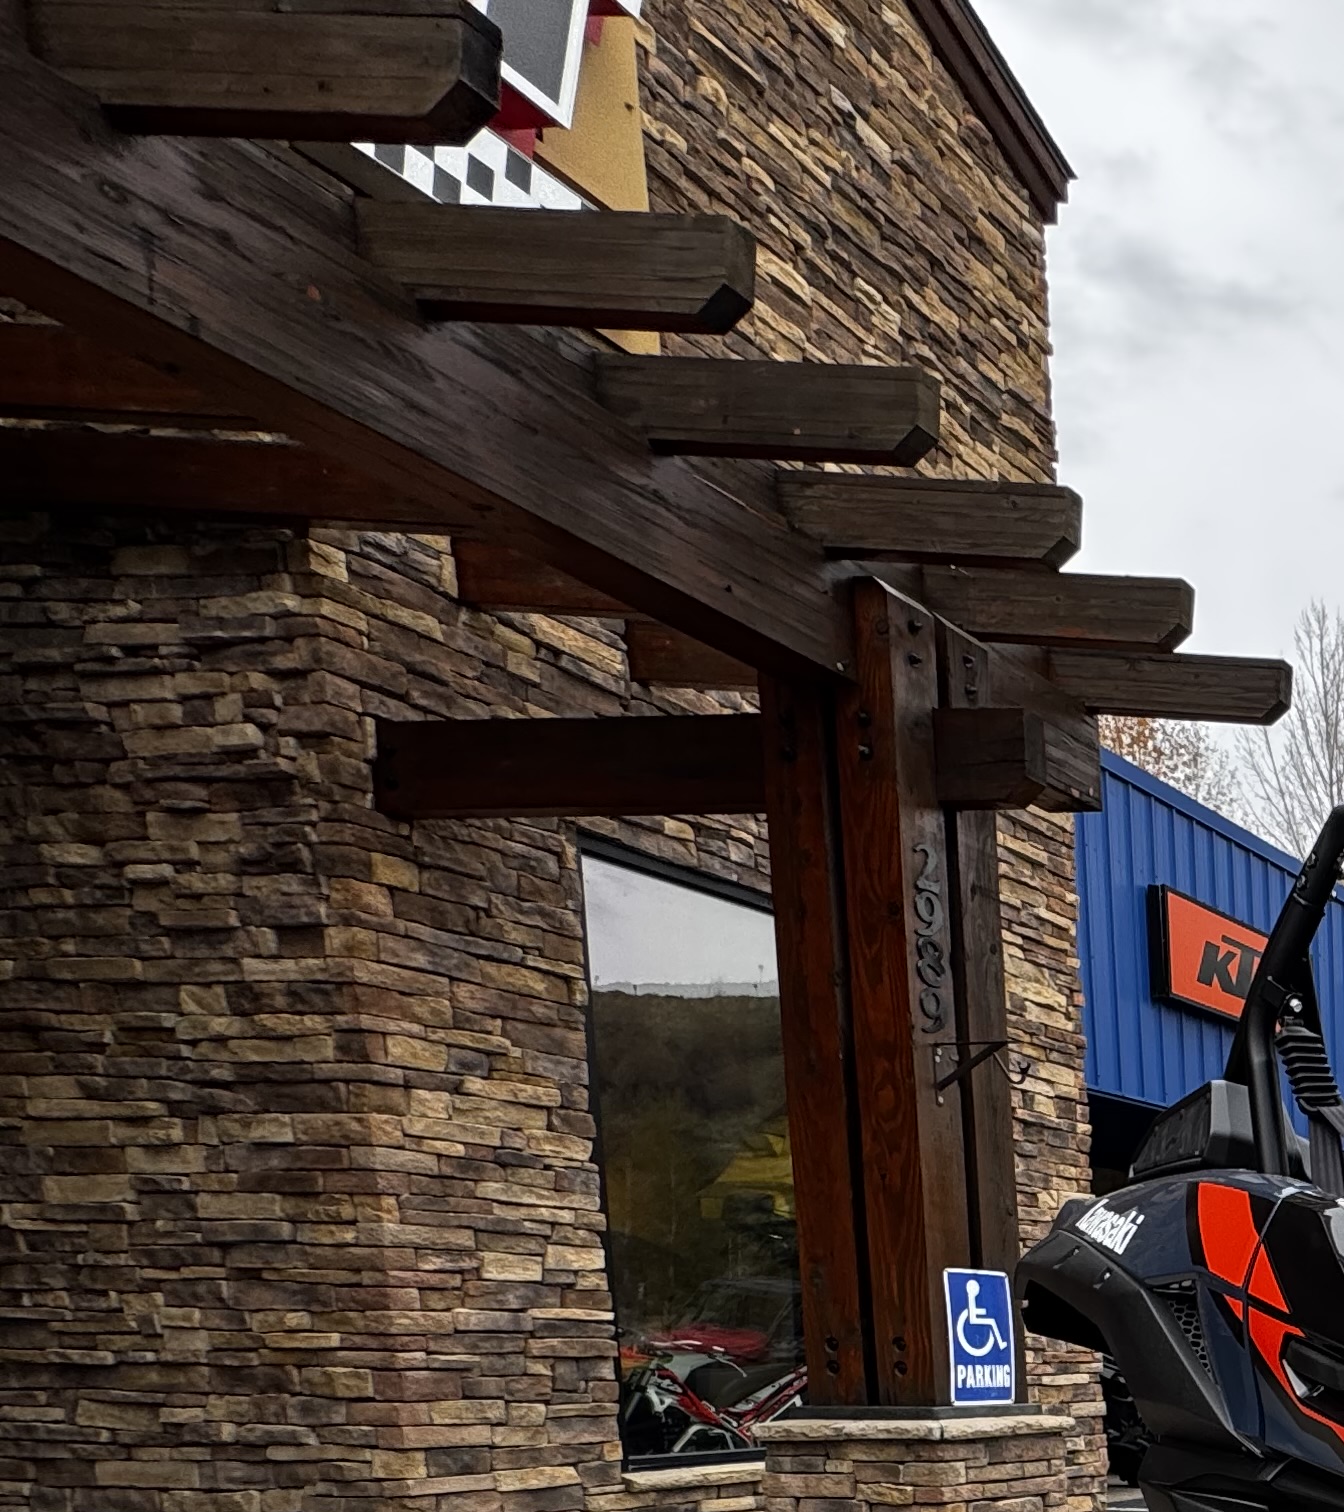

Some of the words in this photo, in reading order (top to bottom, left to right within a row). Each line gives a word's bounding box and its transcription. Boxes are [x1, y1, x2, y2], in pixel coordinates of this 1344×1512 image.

[912, 844, 946, 1034] 2989
[1197, 934, 1266, 1000] KT
[1075, 1199, 1145, 1255] Kawasaki
[957, 1364, 1011, 1388] PARKING
